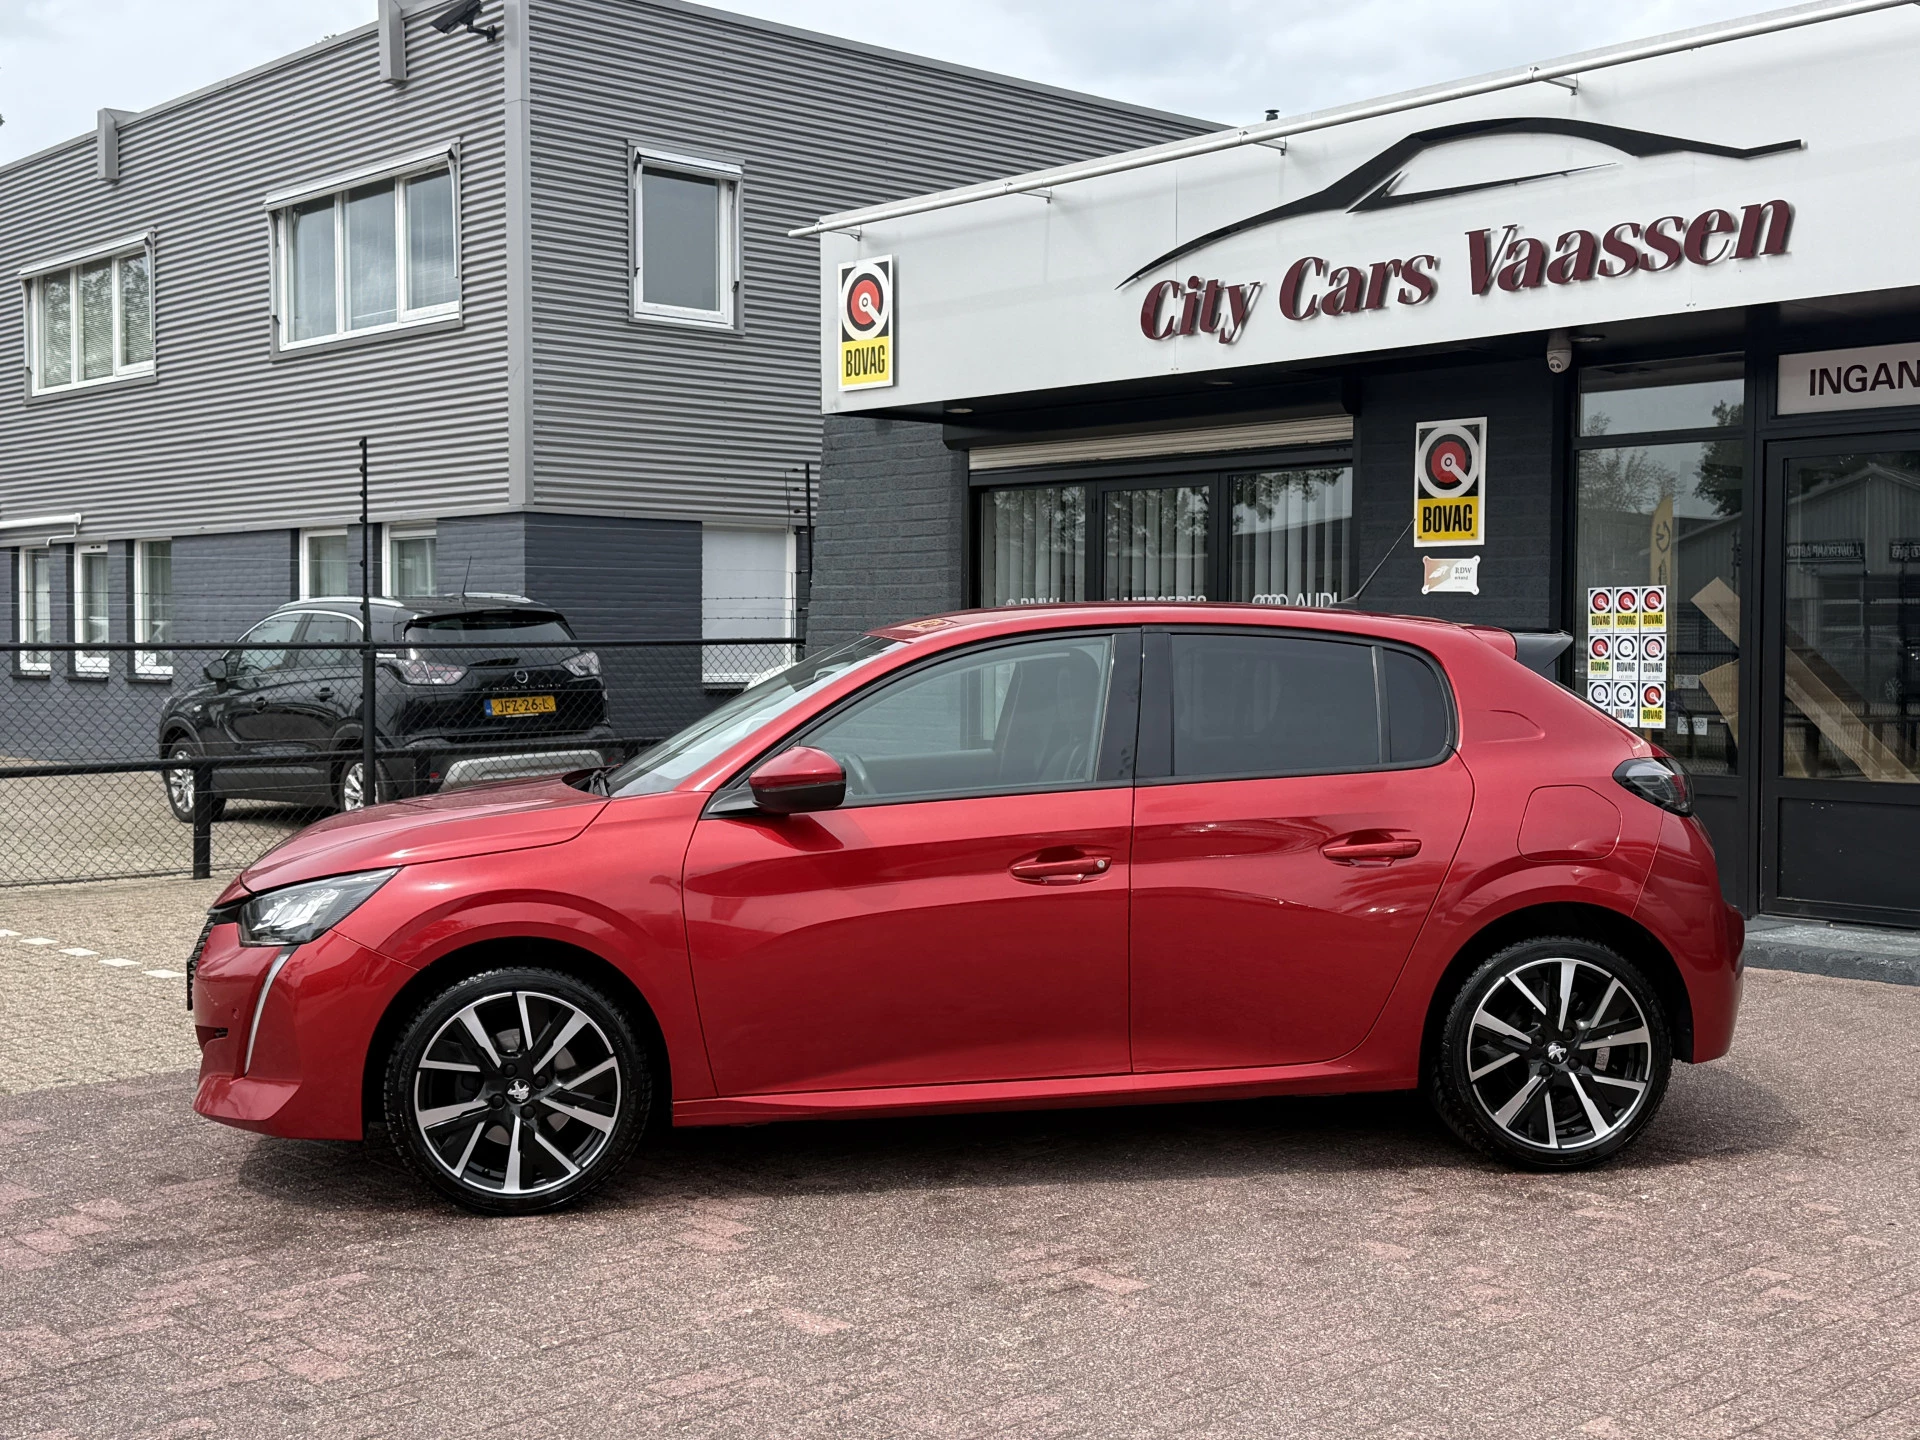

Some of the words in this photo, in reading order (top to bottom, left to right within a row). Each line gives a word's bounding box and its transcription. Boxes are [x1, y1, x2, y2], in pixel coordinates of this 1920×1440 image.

[1140, 276, 1261, 344] City
[1279, 255, 1435, 321] Cars
[1465, 199, 1793, 296] Vaassen
[846, 345, 885, 377] BOVAG
[1423, 504, 1472, 533] BOVAG
[1455, 566, 1473, 574] RDW
[1295, 592, 1338, 607] AUDI
[1591, 615, 1610, 626] BOVAG
[1617, 615, 1637, 626] BOVAG
[1643, 614, 1663, 625] BOVAG
[1590, 661, 1609, 672] BOVAG
[1616, 661, 1636, 672] BOVAG
[1643, 662, 1663, 673] BOVAG
[499, 698, 550, 713] JFZ-26-L
[1615, 708, 1635, 719] BOVAG
[1642, 709, 1662, 720] BOVAG
